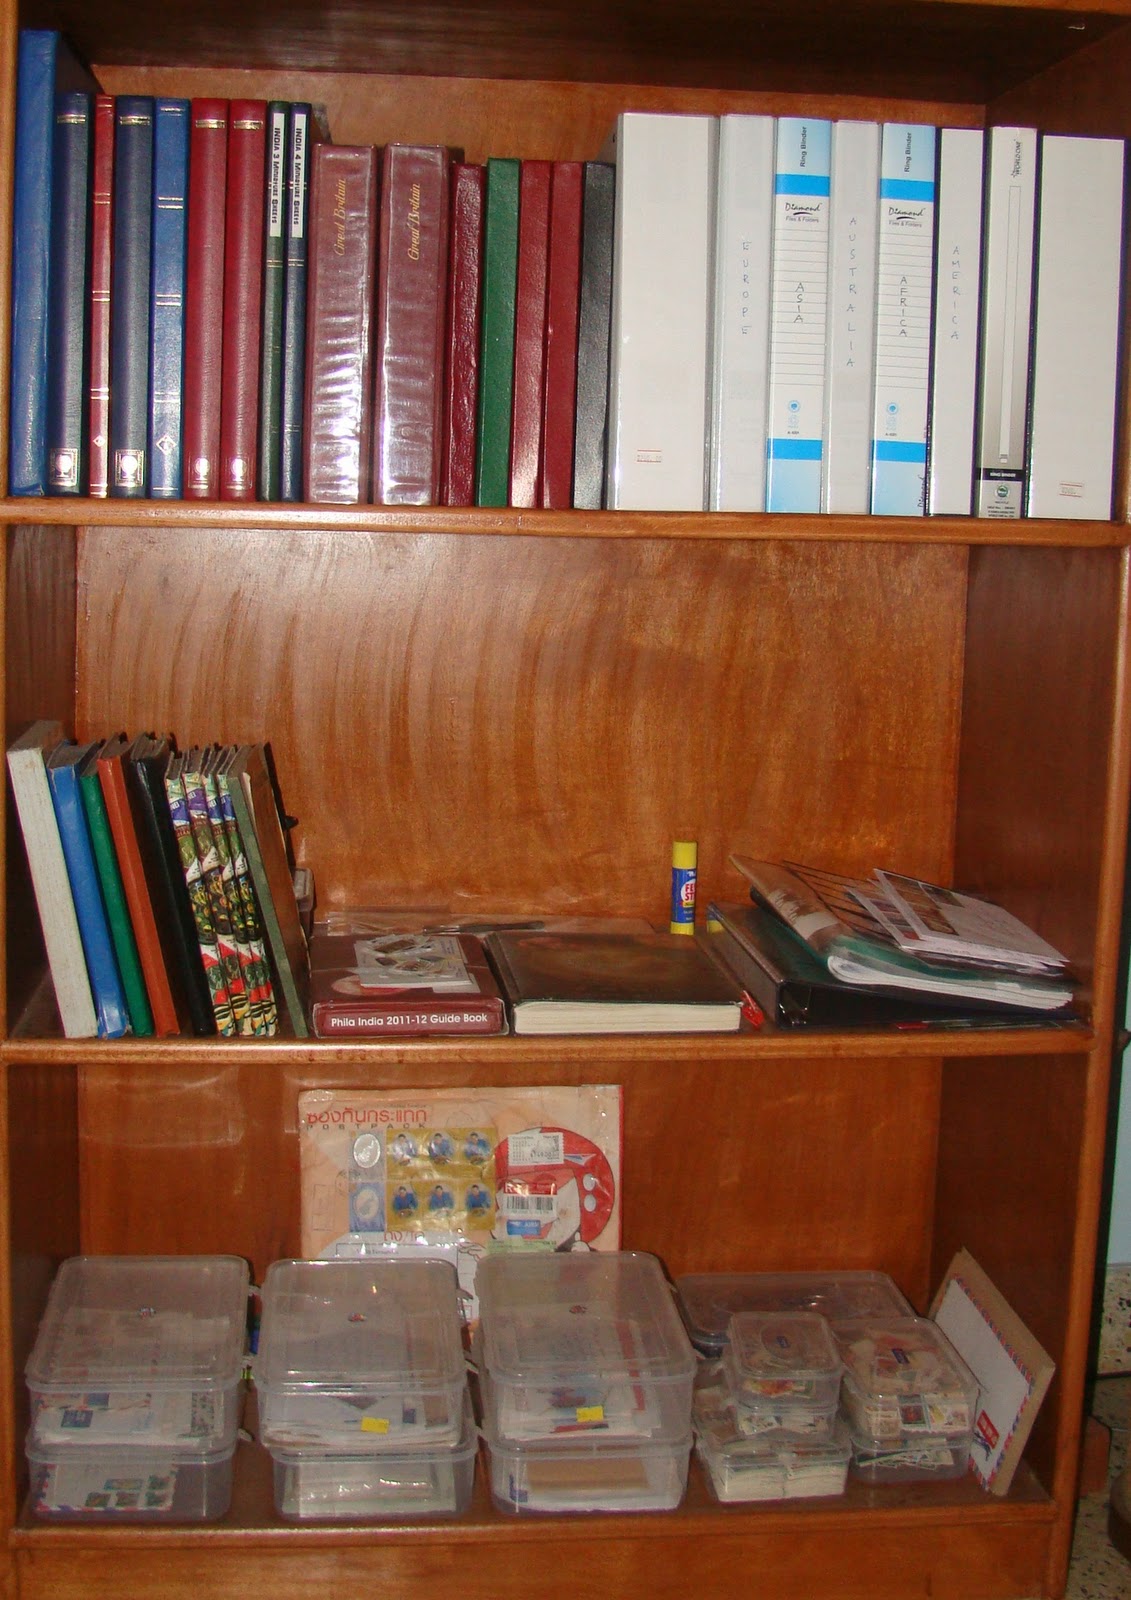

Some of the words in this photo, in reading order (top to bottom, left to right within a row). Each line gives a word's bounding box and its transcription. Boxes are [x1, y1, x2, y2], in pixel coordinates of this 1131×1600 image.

[273, 127, 281, 151] INDIA
[904, 132, 912, 155] Binder
[904, 155, 912, 173] Ring
[408, 183, 420, 225] Britain
[785, 202, 822, 212] Diamond
[888, 207, 926, 217] Diamond
[406, 222, 420, 261] Great
[742, 241, 752, 335] EUROPE
[793, 282, 805, 323] ASIA
[846, 217, 857, 367] AUSTRALIA
[951, 246, 961, 340] AMERICA
[899, 276, 908, 337] AFRICA
[685, 883, 695, 892] FE
[331, 1018, 356, 1027] Phila
[358, 1017, 384, 1026] India
[386, 1015, 428, 1026] 2011-12
[430, 1014, 461, 1024] Guide
[464, 1013, 488, 1023] Book
